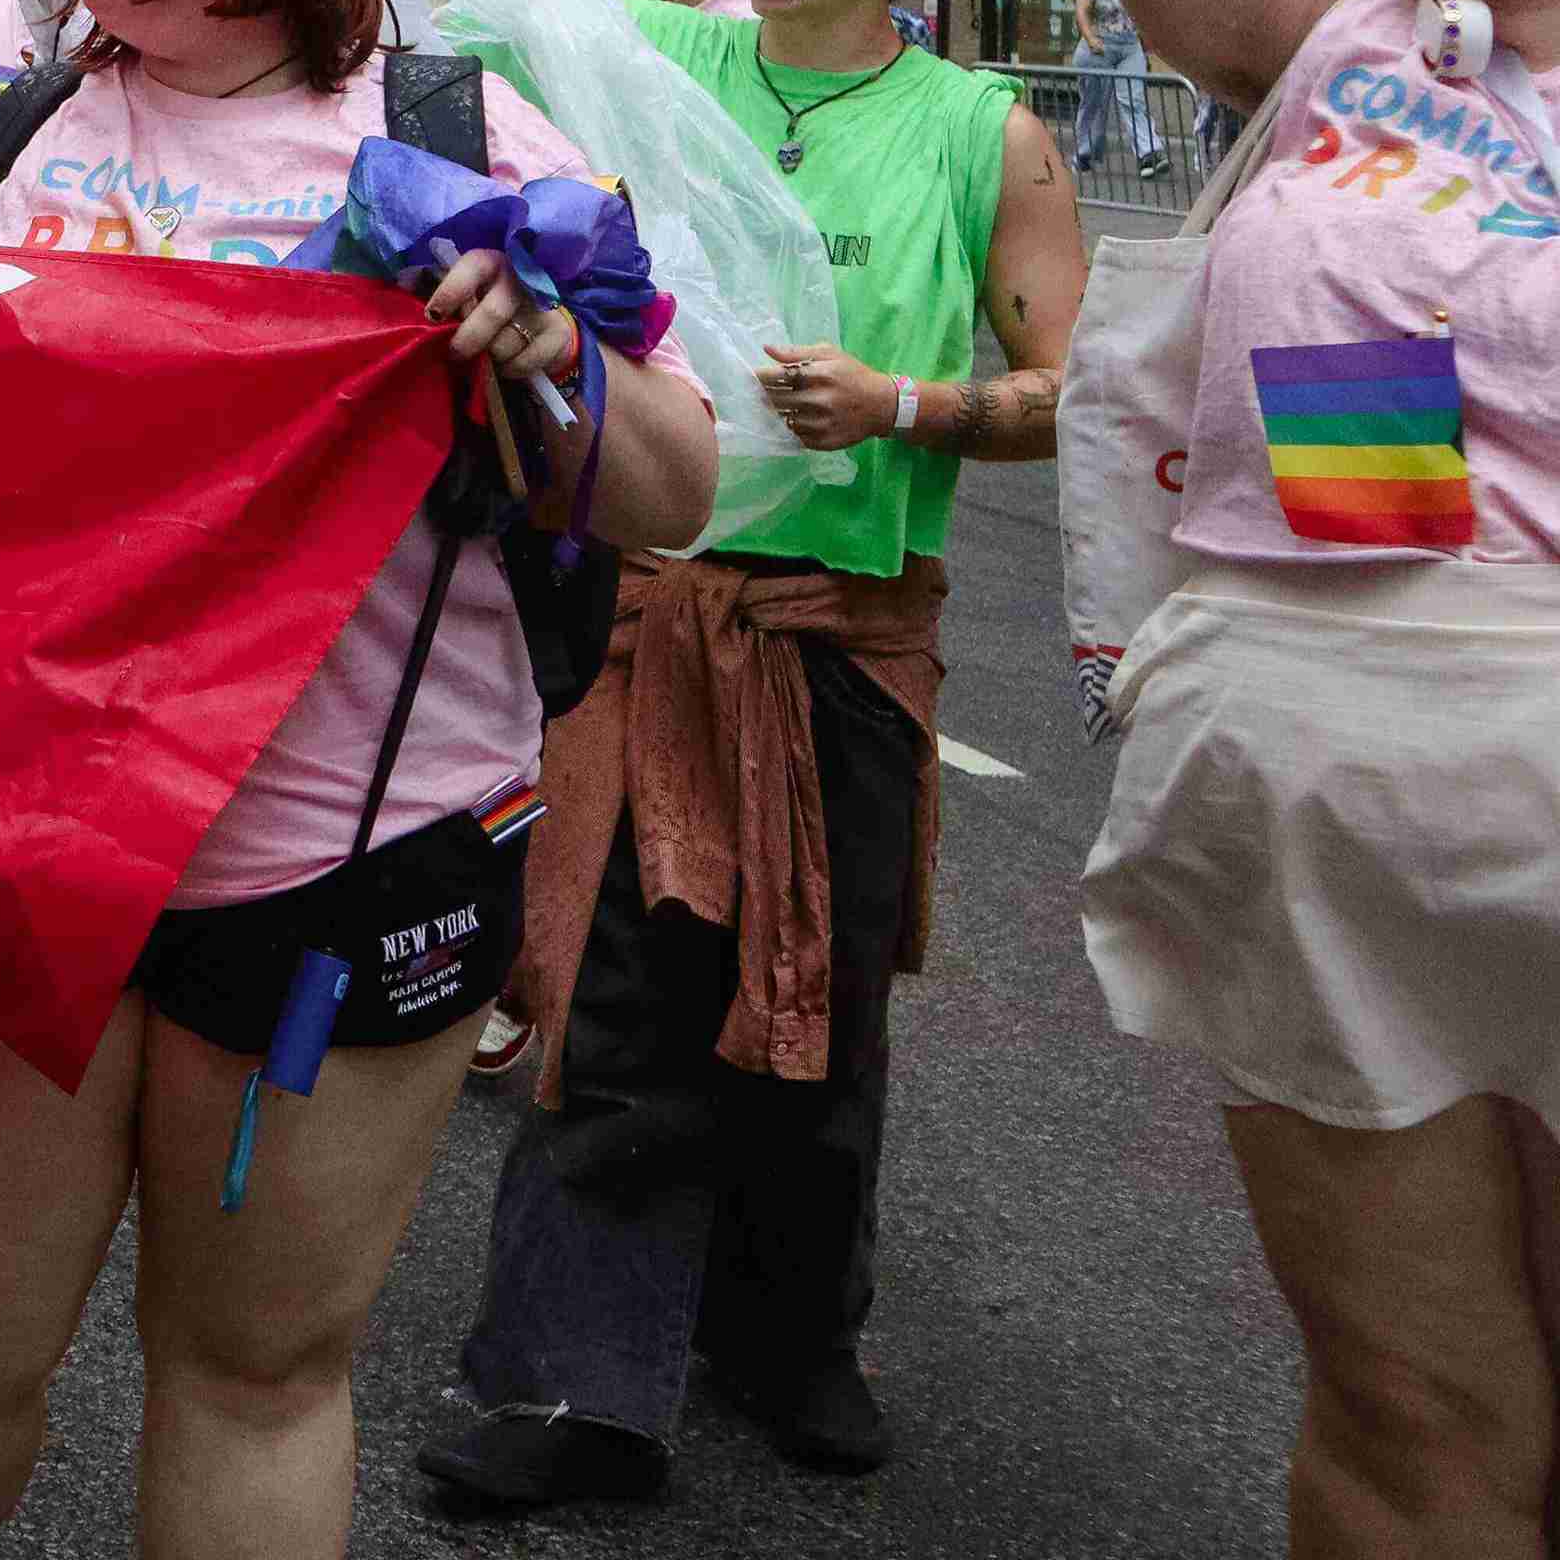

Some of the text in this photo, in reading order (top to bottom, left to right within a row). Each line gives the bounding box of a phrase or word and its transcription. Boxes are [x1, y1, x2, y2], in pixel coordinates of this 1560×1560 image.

[380, 903, 480, 962] NEW YORK
[389, 983, 419, 1001] MAIN
[421, 960, 462, 988] CAMPUS
